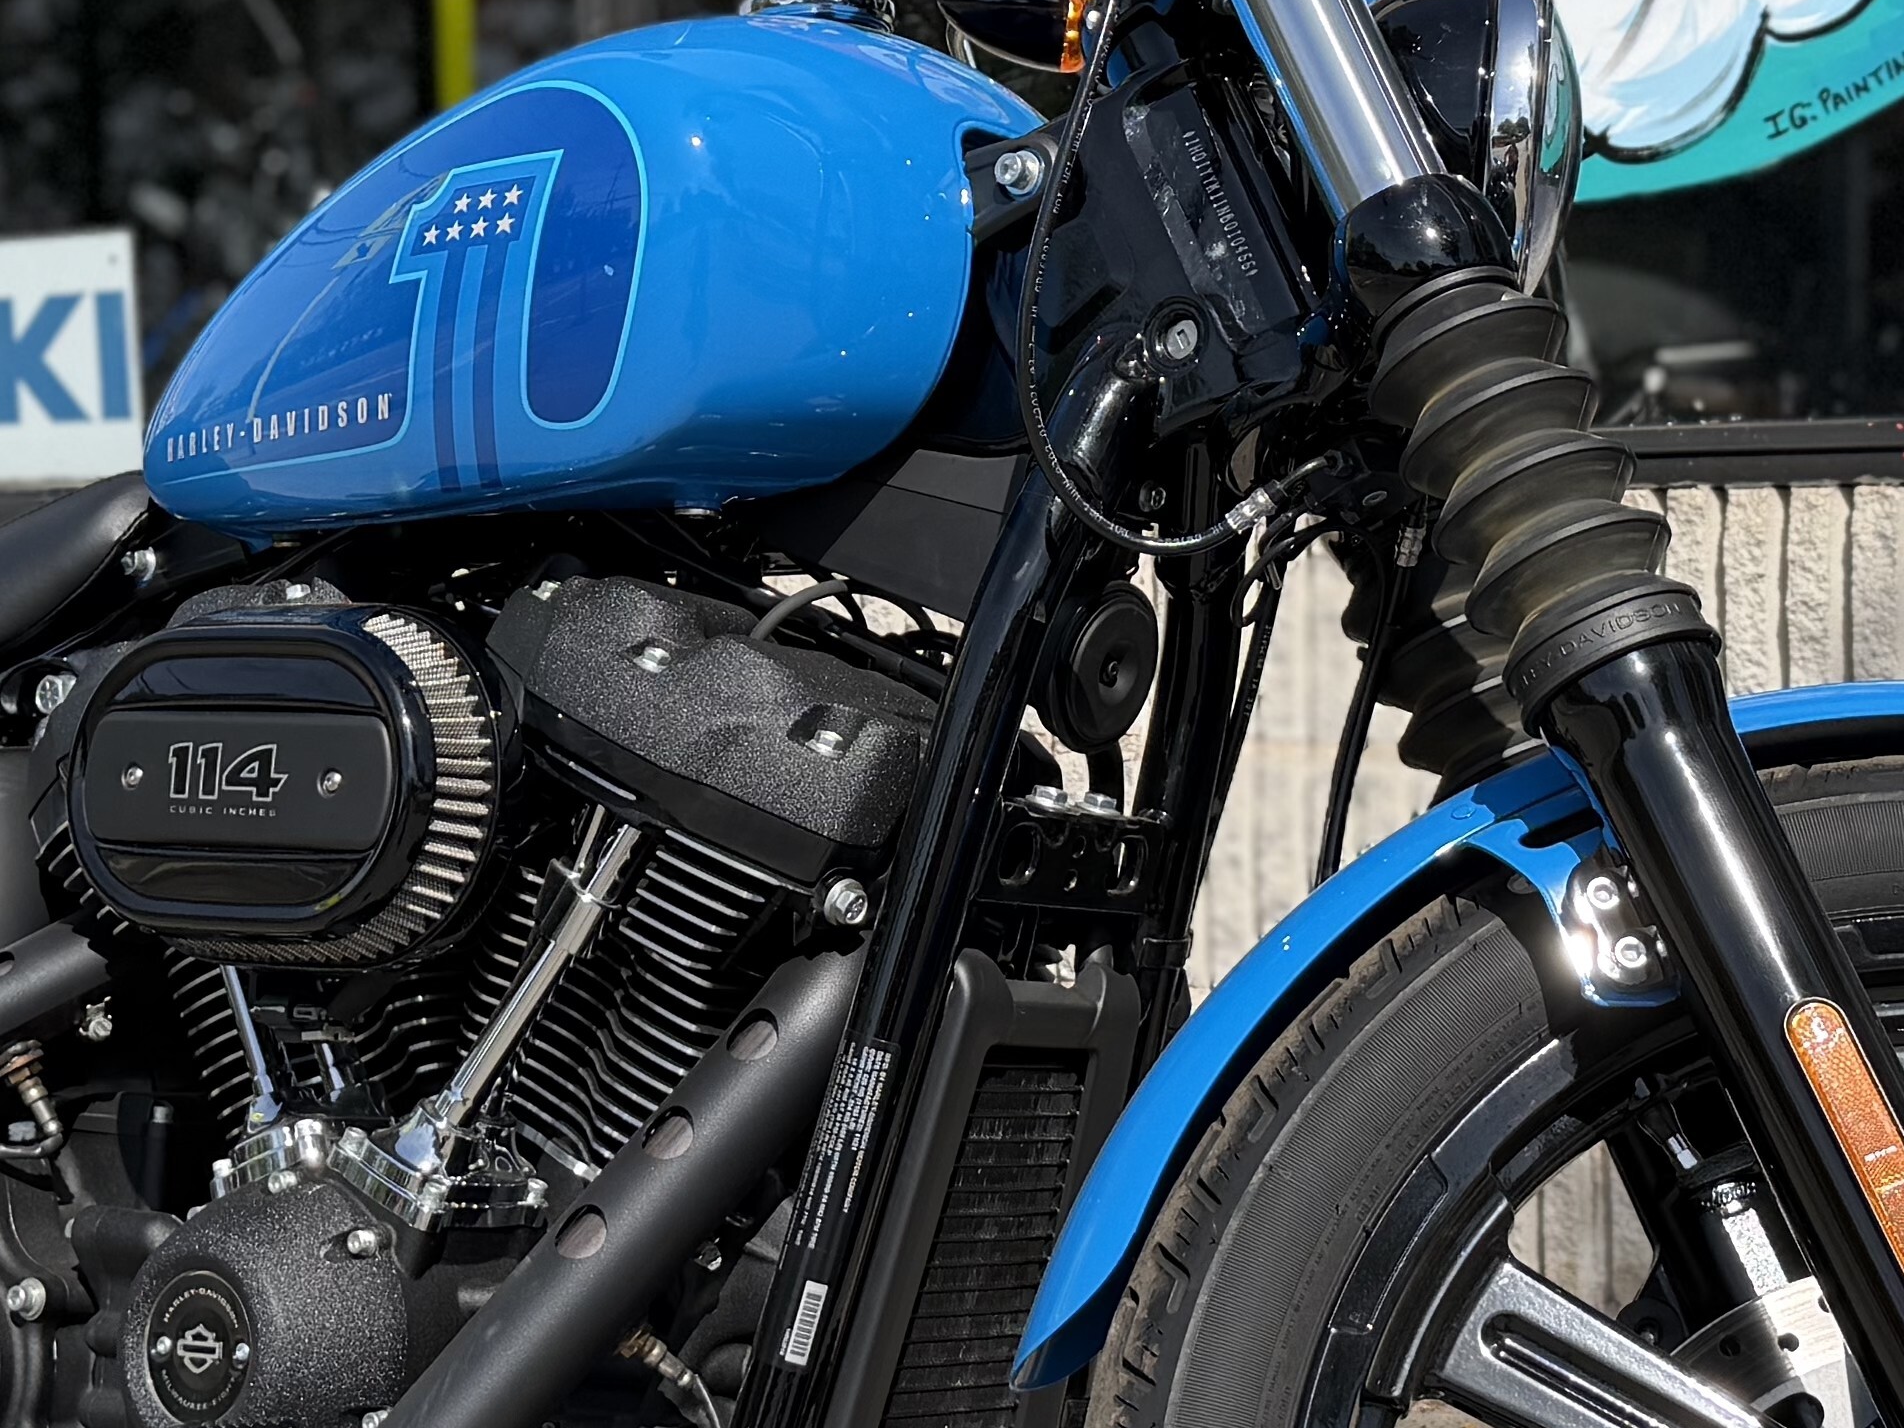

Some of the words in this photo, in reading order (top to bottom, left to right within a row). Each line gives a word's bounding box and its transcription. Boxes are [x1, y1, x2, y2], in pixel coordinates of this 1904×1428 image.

[165, 392, 394, 464] HARLEY-DAVIDSON
[167, 741, 288, 802] 114
[169, 805, 214, 816] CUBIC
[222, 806, 277, 818] INCHES
[162, 1287, 239, 1329] HARLEY-DAVIDSON
